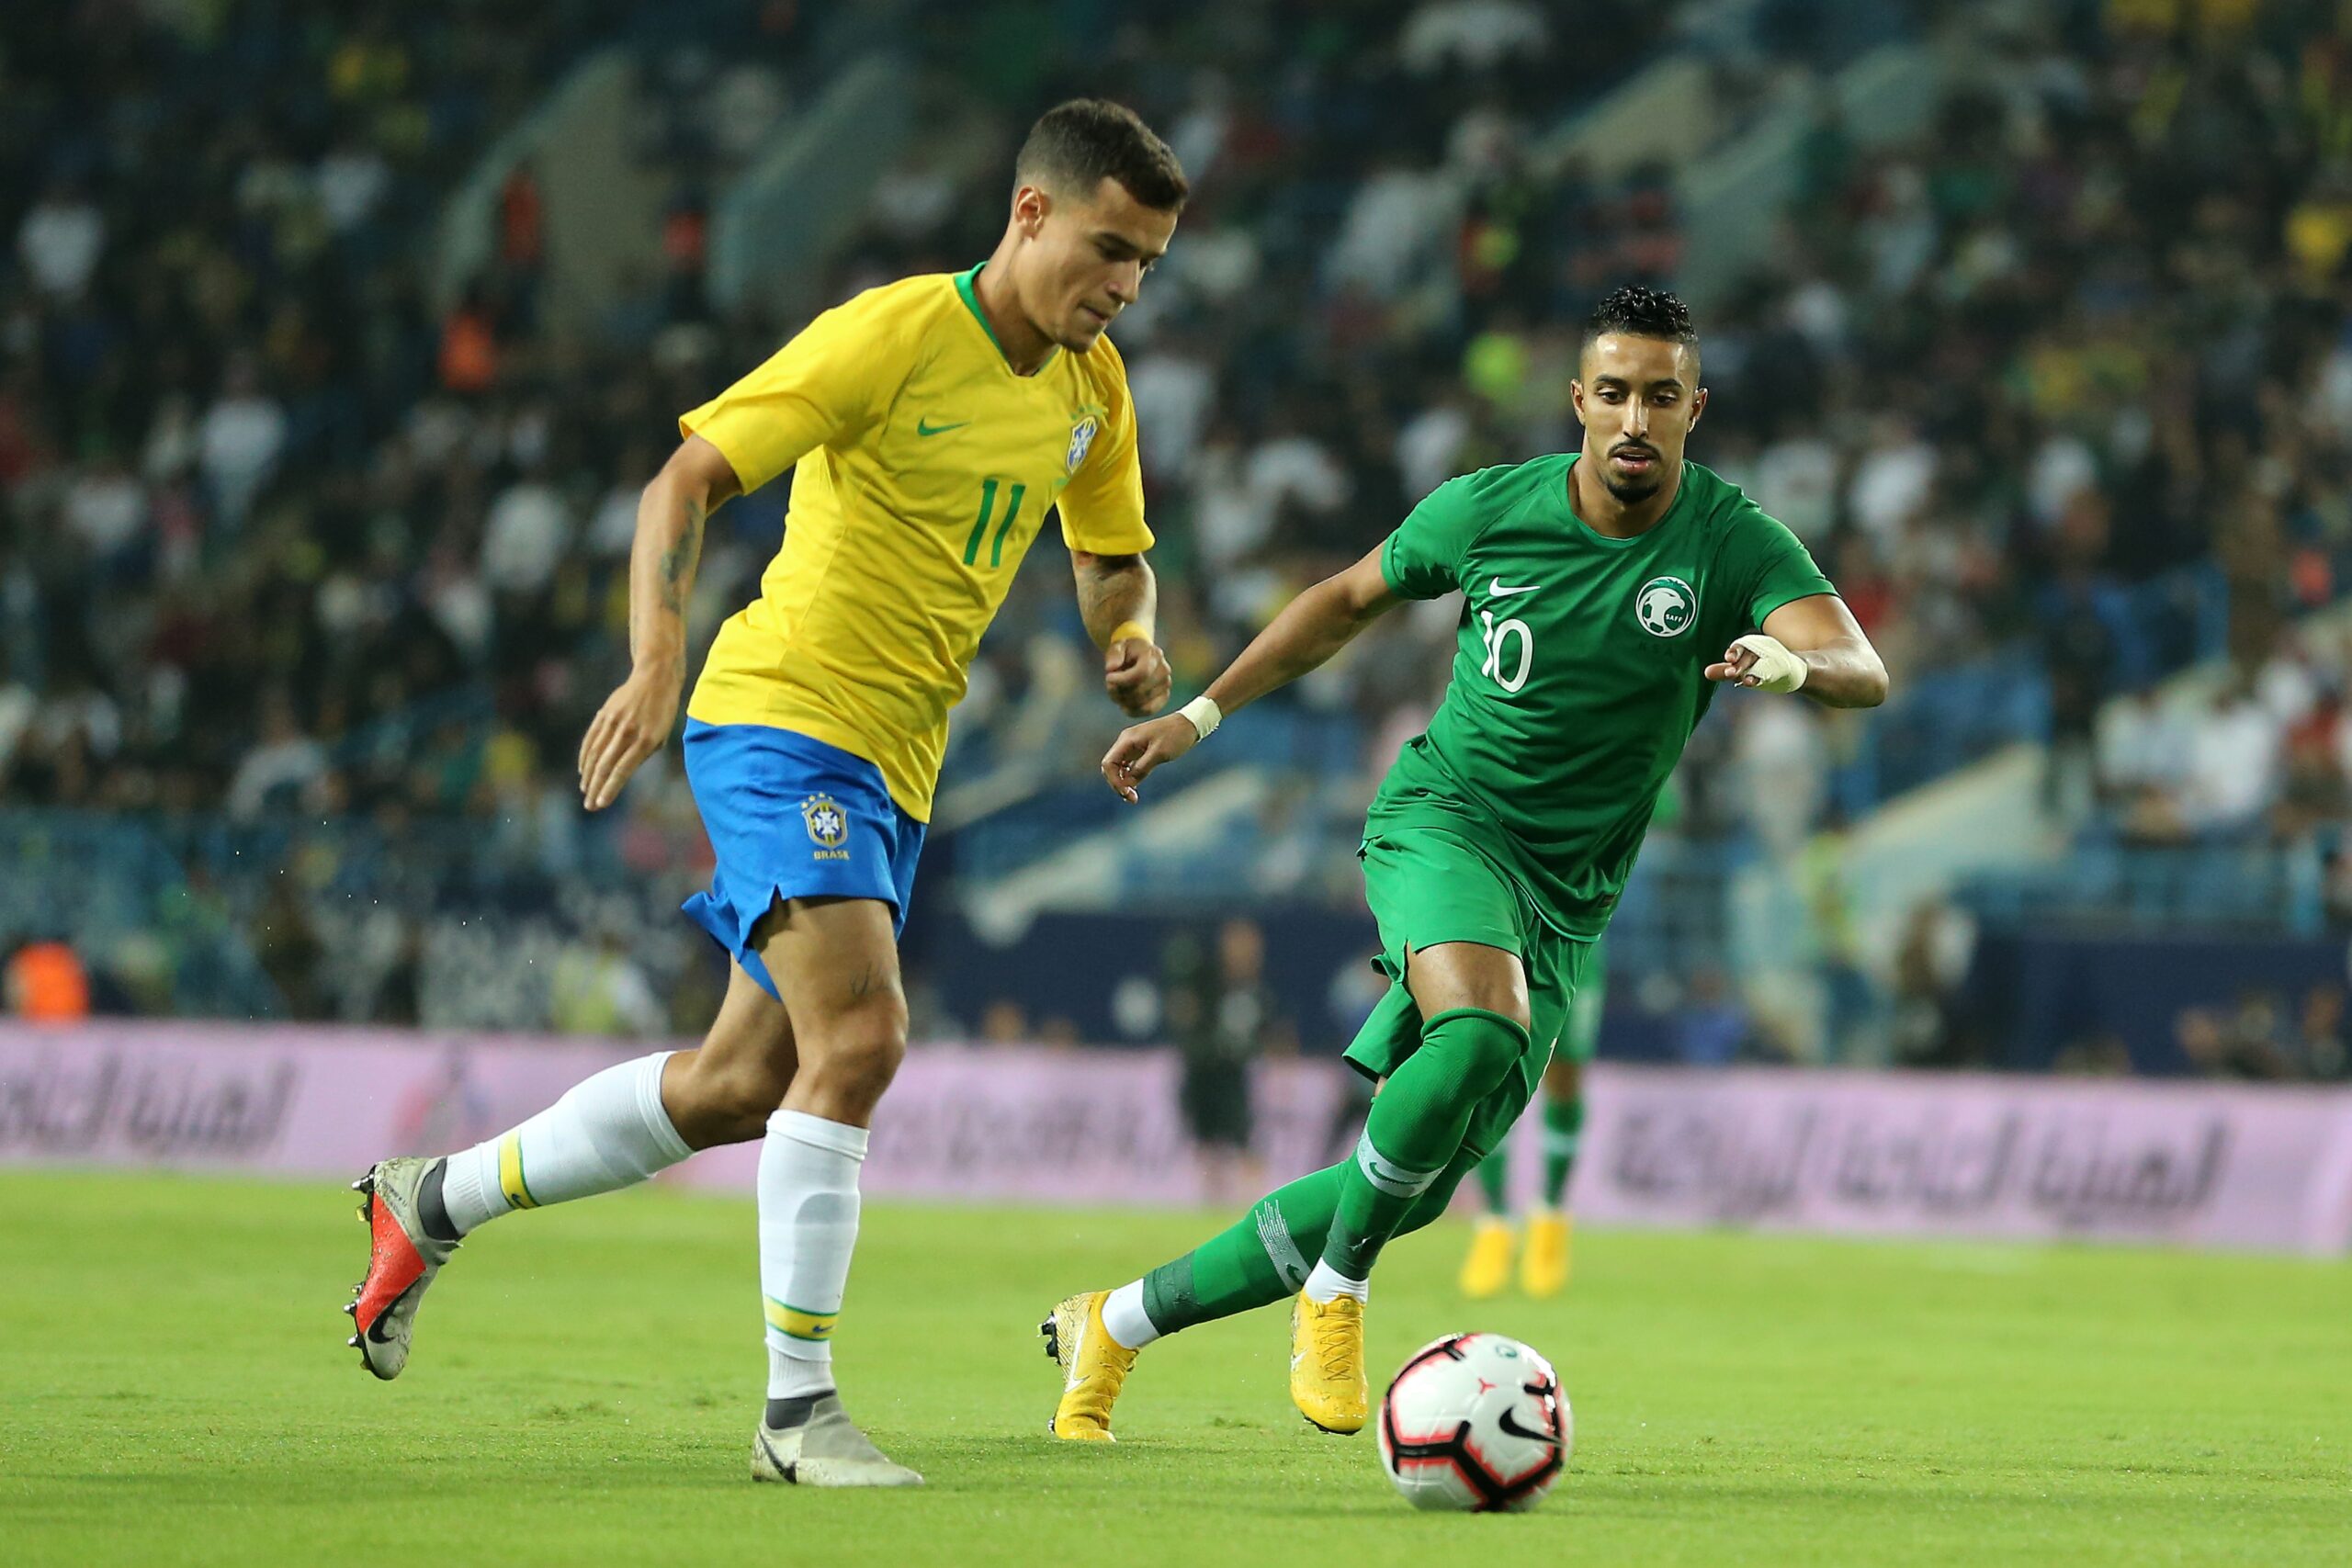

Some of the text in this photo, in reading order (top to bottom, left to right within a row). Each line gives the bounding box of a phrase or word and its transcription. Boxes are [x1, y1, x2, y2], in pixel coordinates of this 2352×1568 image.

[963, 479, 1026, 568] 11
[1480, 610, 1533, 694] 10
[1665, 614, 1683, 623] SAFF
